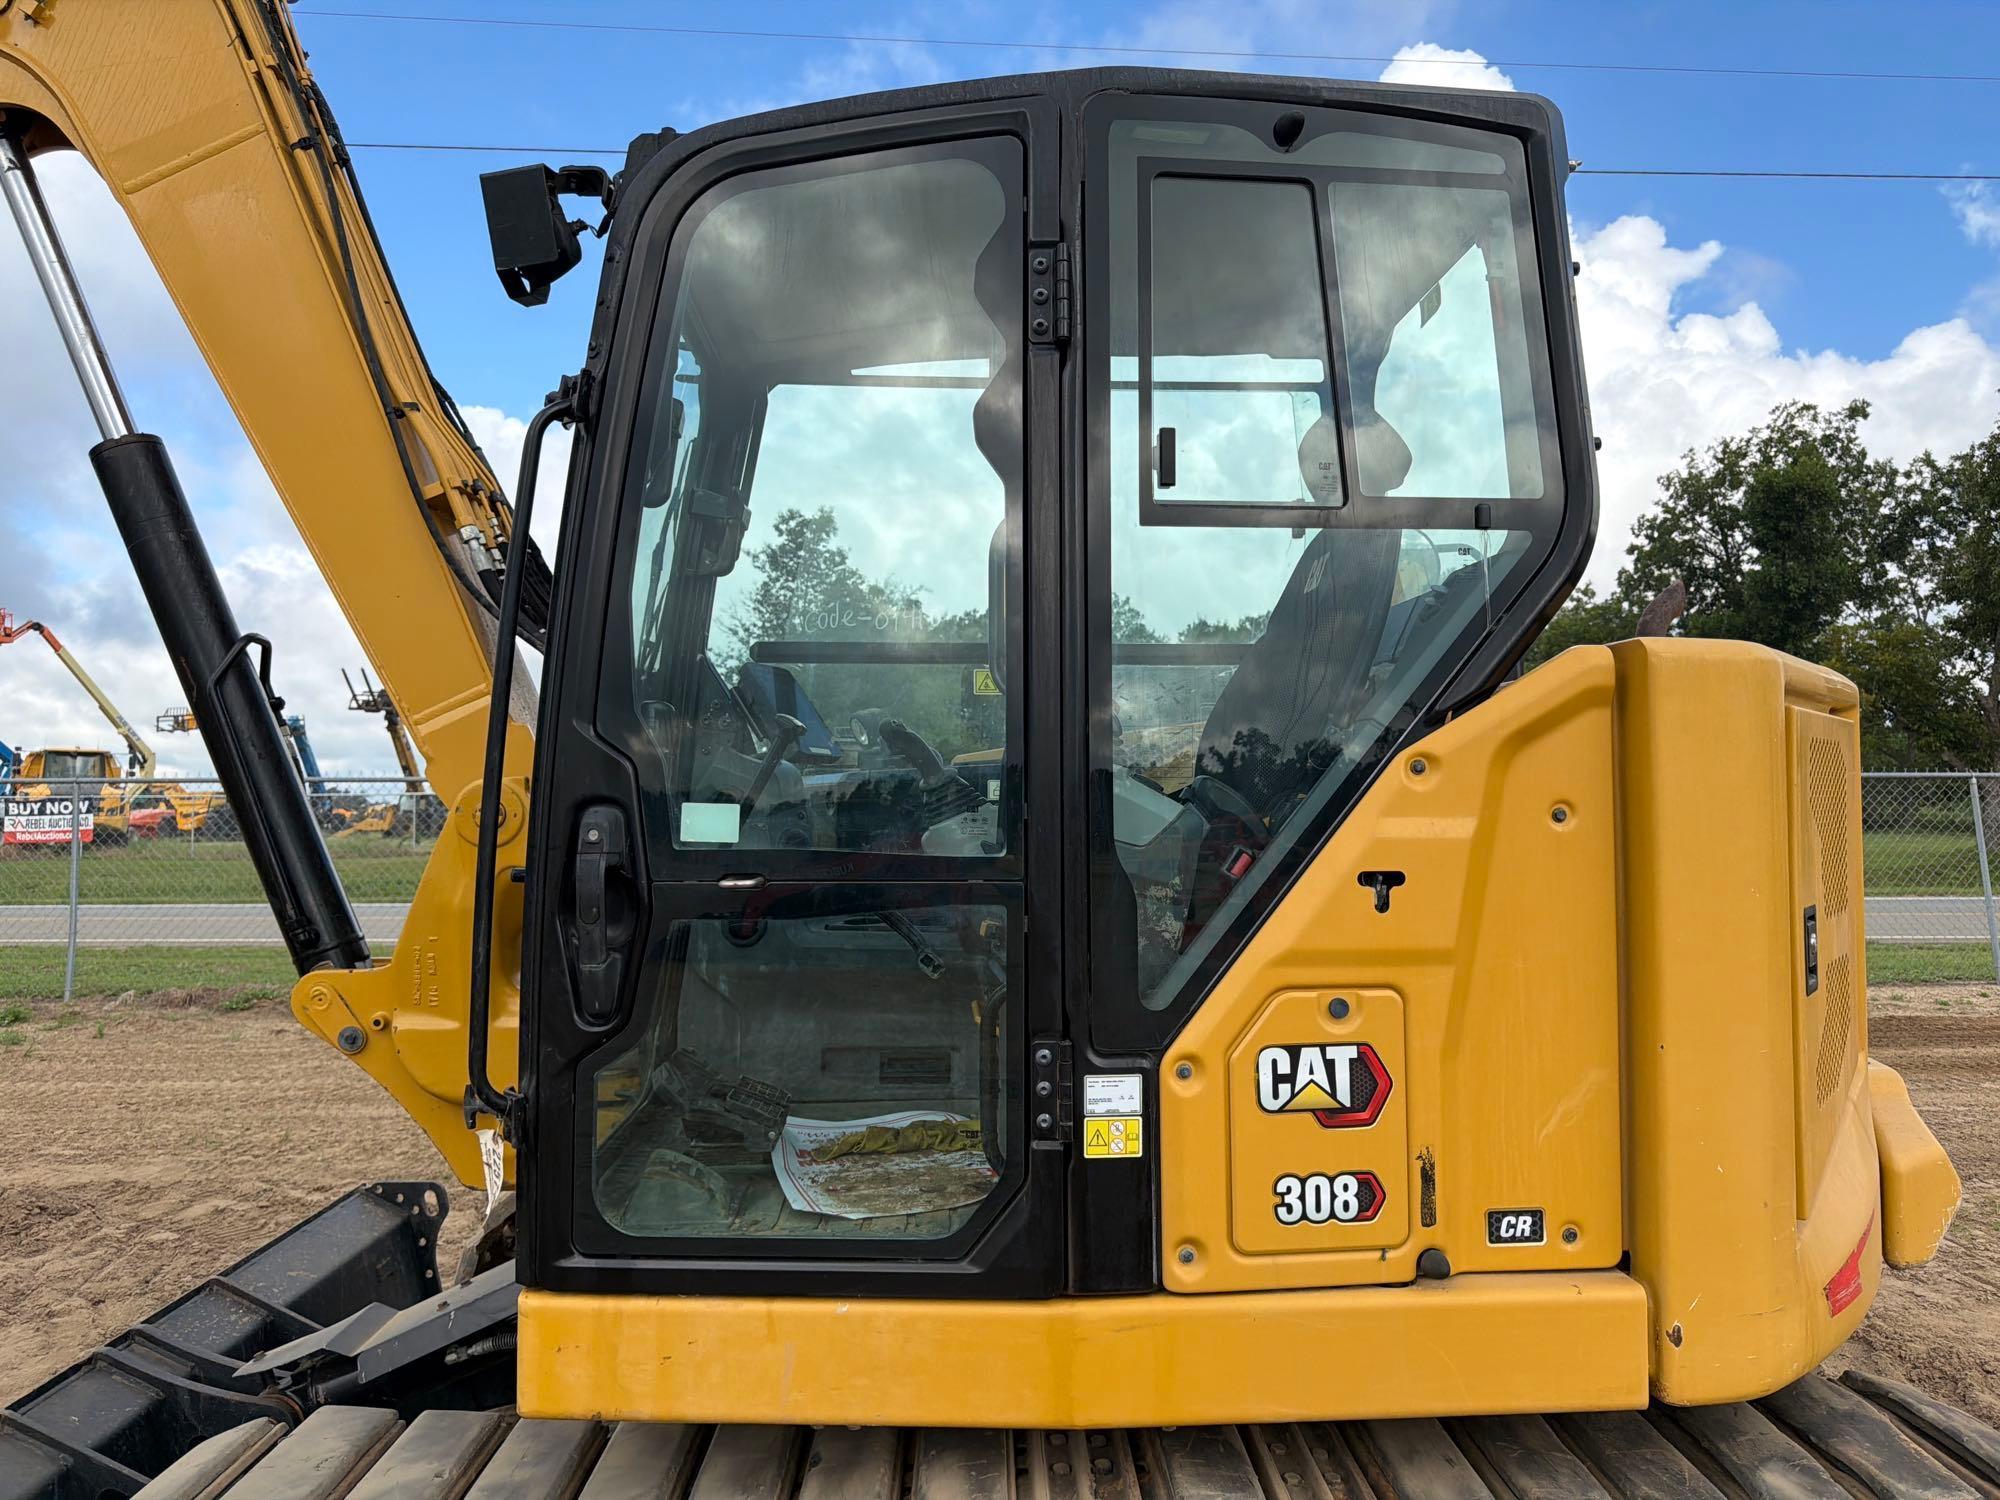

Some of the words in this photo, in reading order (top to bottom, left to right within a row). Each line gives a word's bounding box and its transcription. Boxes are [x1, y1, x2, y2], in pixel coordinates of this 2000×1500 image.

[1457, 547, 1471, 556] CAT
[8, 801, 42, 815] BUY
[25, 818, 46, 830] REBEL
[48, 817, 74, 829] AUCTIO
[1257, 1045, 1358, 1111] CAT
[1275, 1174, 1359, 1223] 308
[1500, 1215, 1533, 1238] CR
